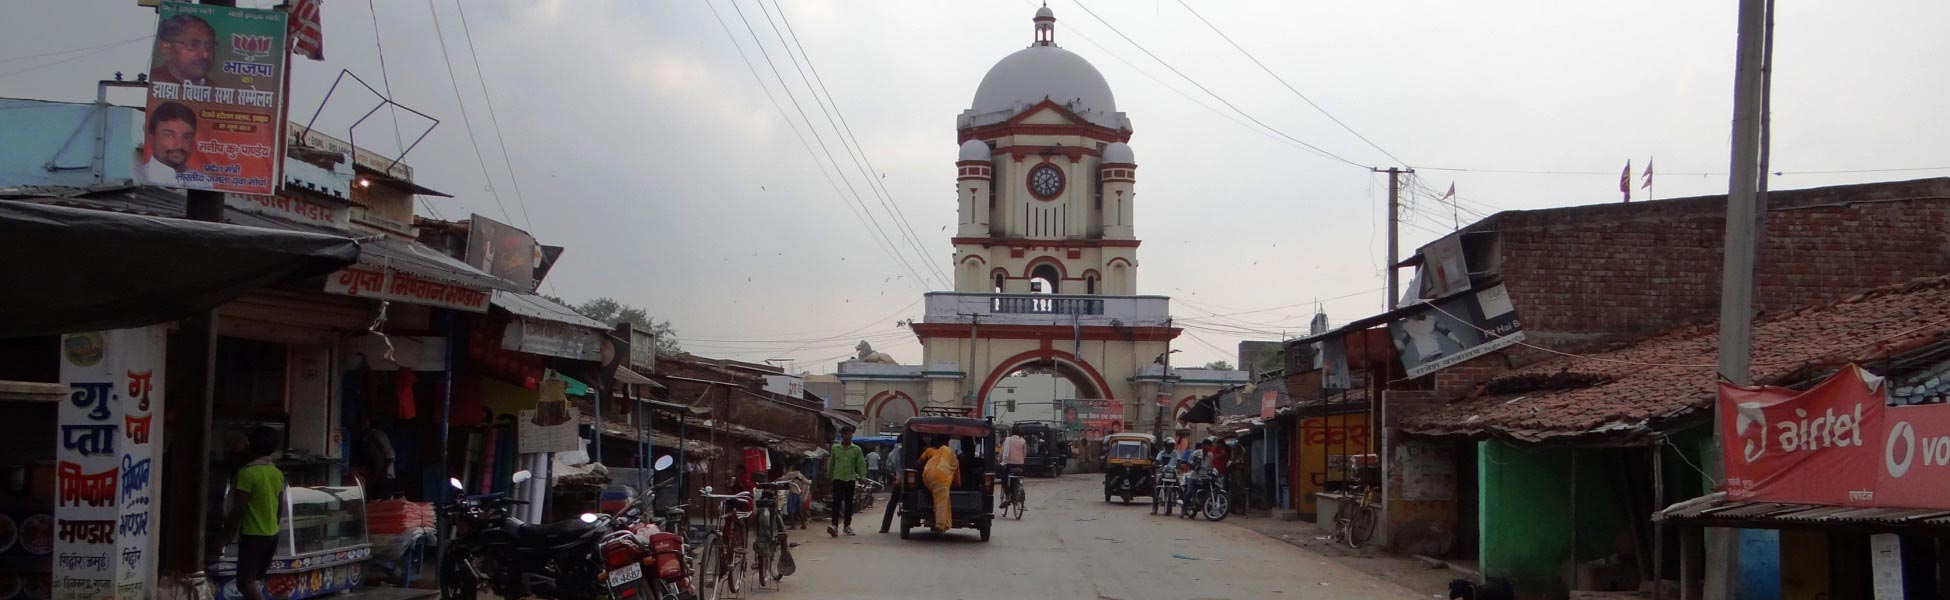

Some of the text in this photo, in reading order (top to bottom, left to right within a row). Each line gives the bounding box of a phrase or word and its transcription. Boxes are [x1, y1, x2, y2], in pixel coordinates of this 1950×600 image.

[223, 61, 275, 77] भाजपा
[339, 268, 385, 295] गुप्ता
[1497, 322, 1512, 334] Hai
[1777, 403, 1863, 452] airtel
[58, 518, 116, 545] भण्डार
